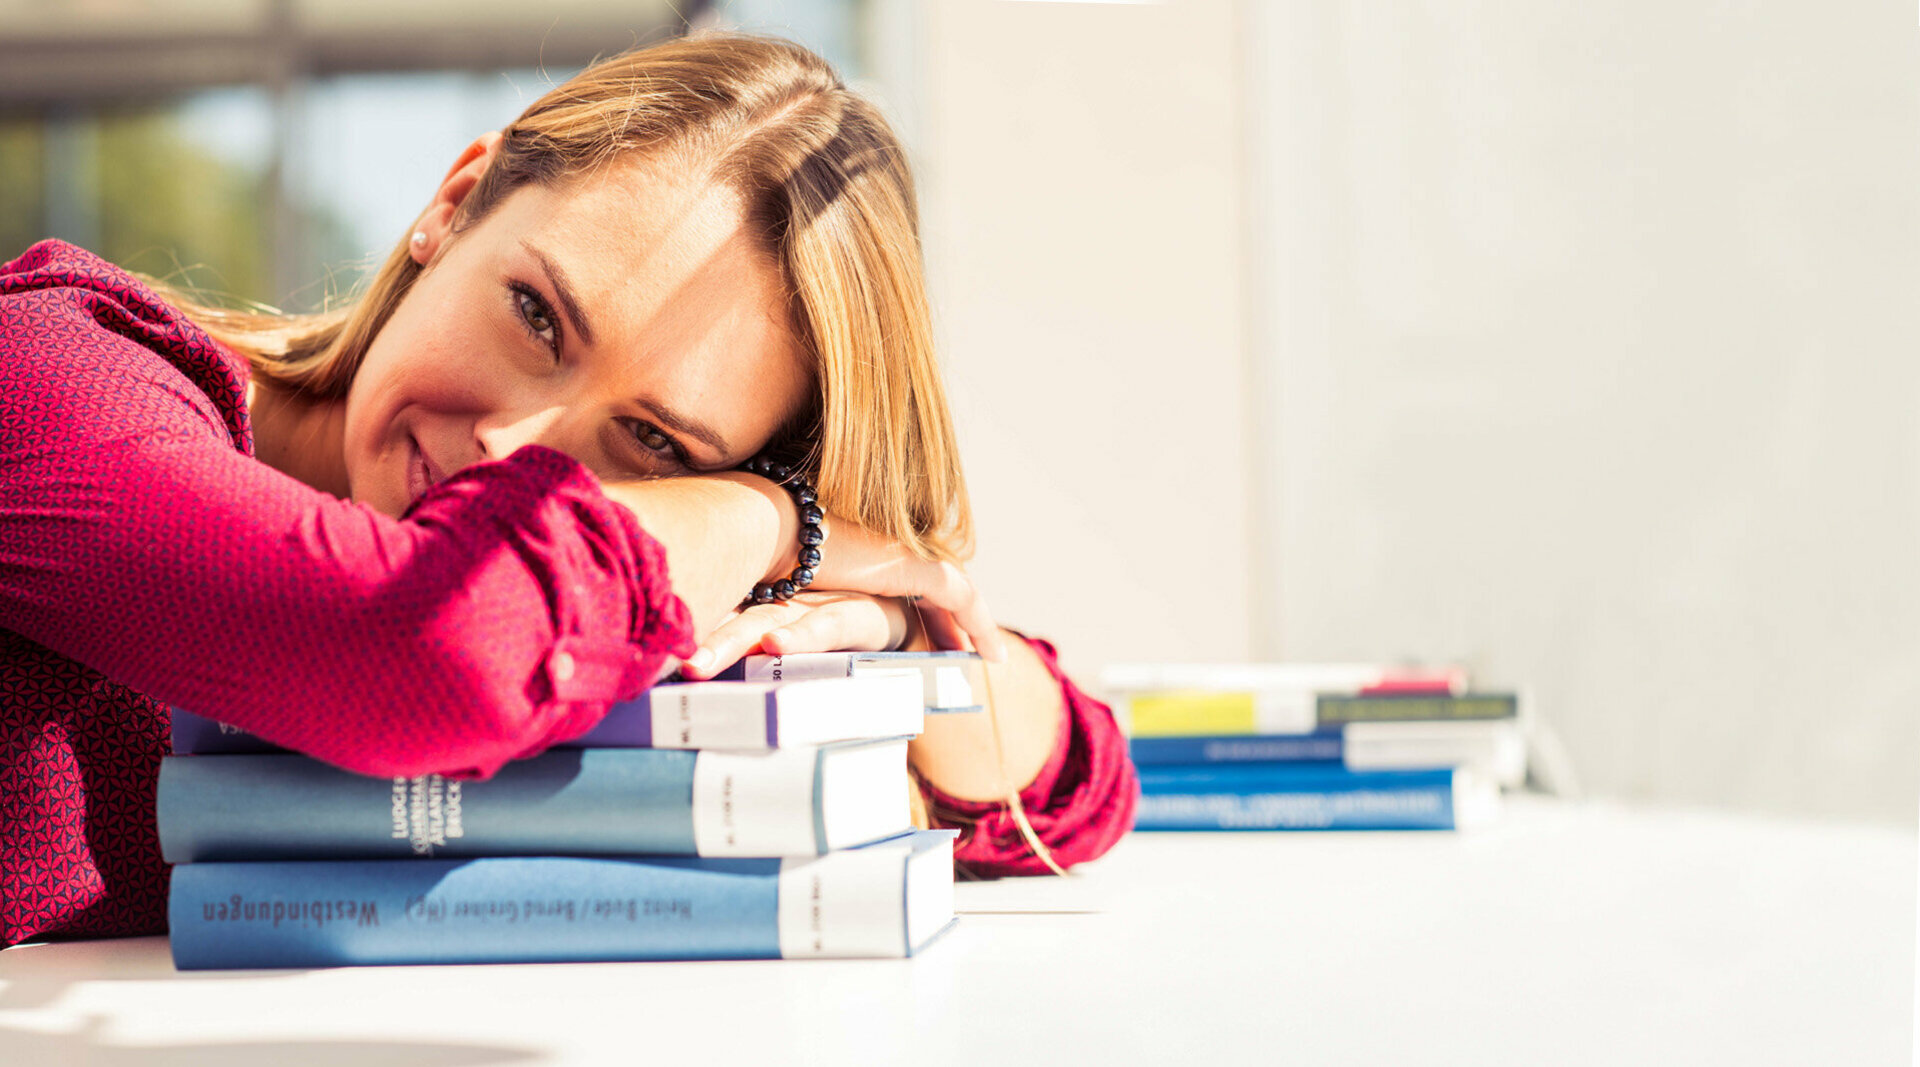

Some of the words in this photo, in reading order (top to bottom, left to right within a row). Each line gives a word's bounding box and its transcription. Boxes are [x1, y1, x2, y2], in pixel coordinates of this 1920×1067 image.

[202, 894, 380, 928] Westbindungen
[455, 899, 519, 923] Greiner
[524, 899, 576, 922] Bernd
[594, 899, 637, 922] Bude
